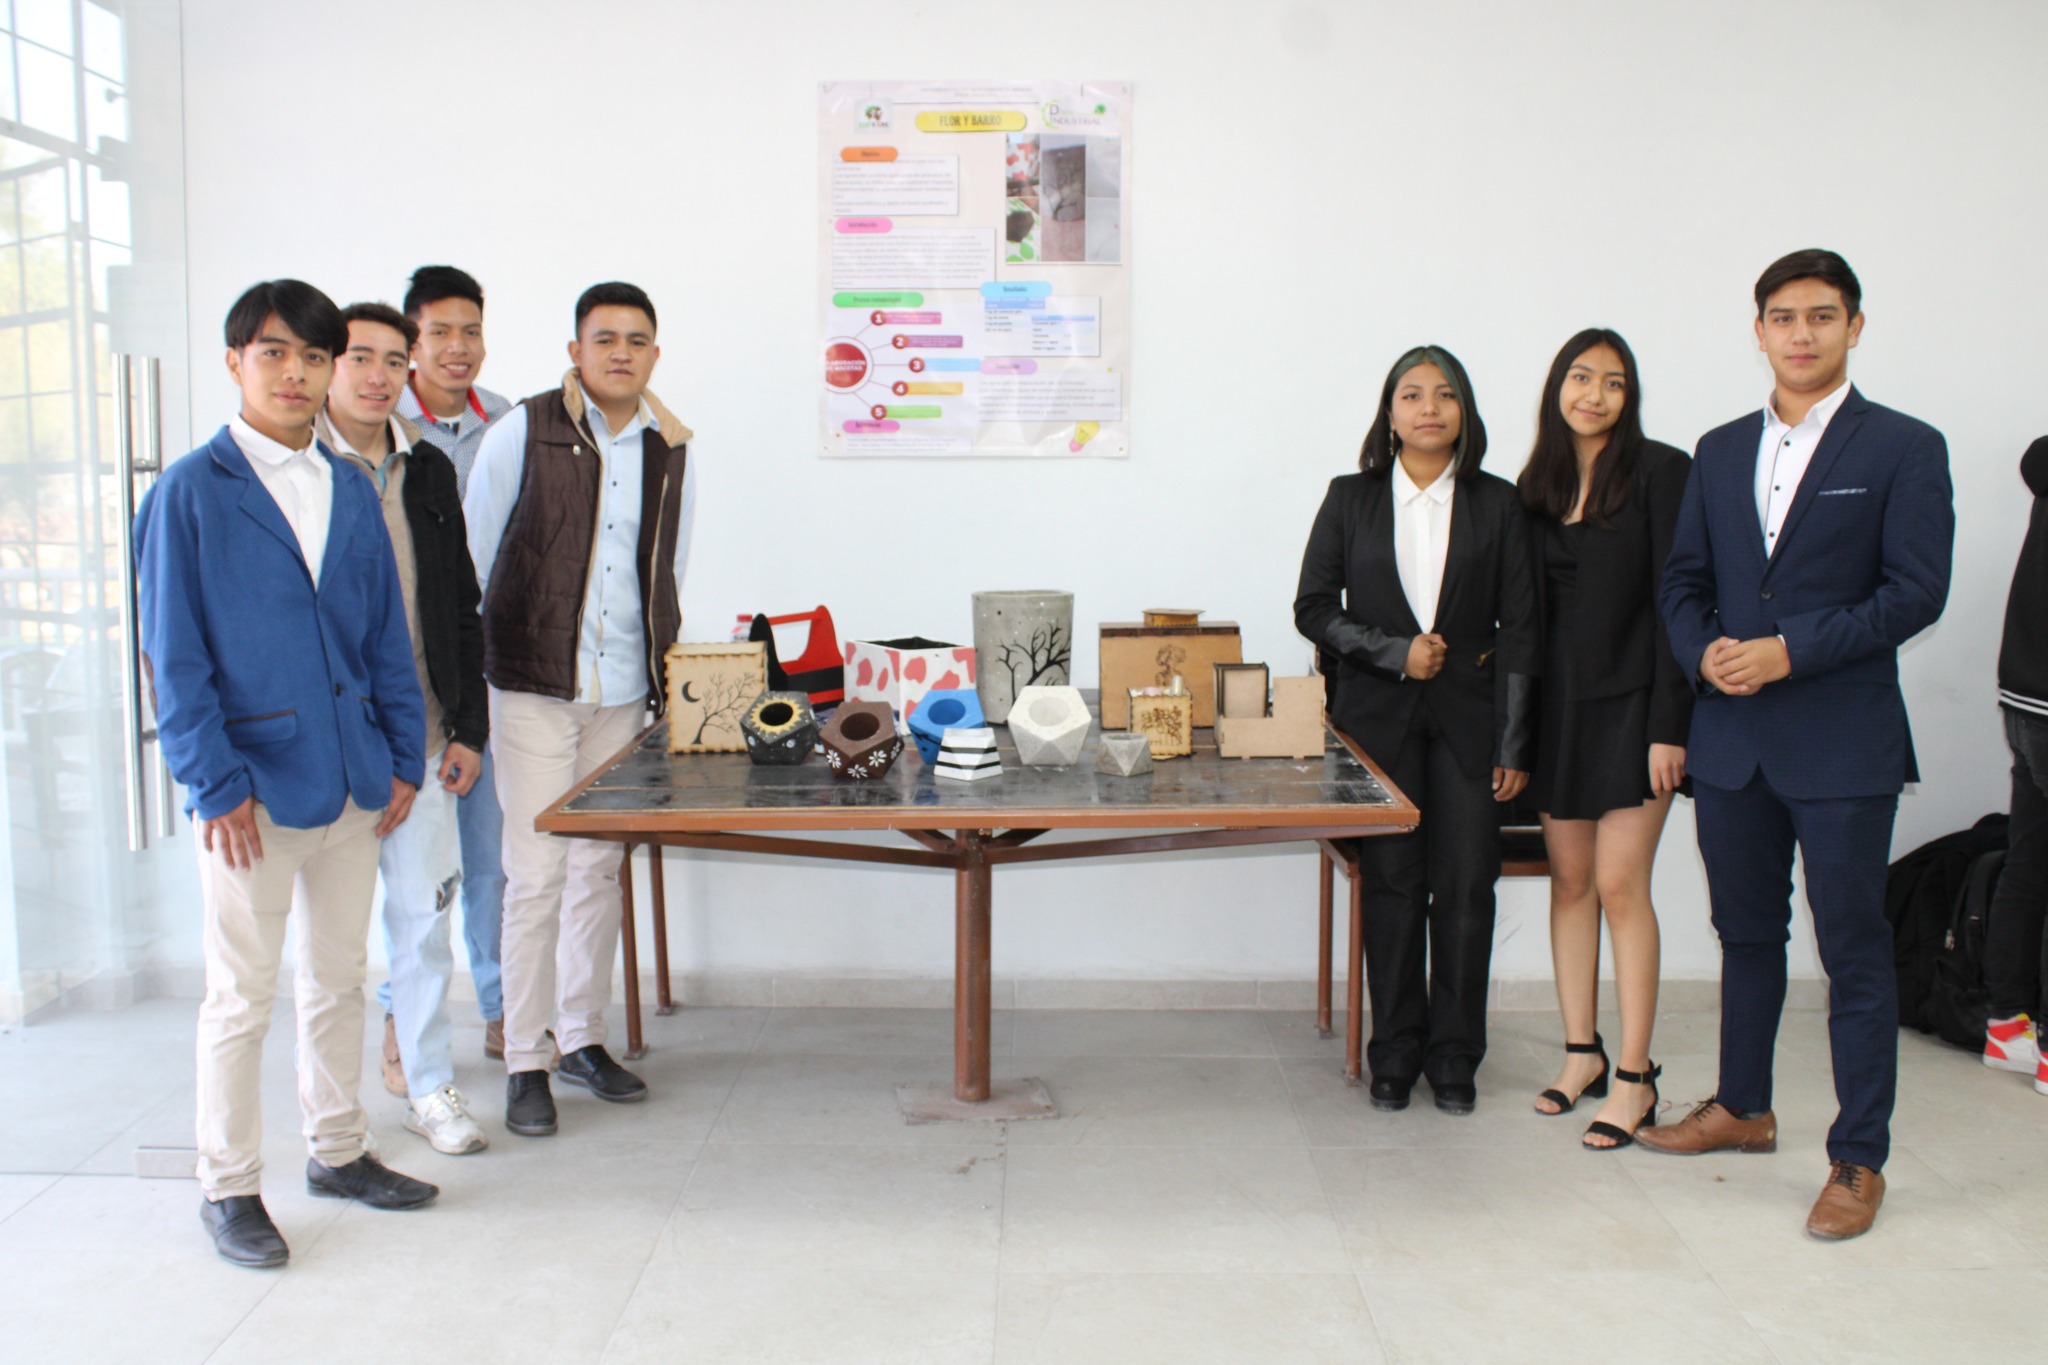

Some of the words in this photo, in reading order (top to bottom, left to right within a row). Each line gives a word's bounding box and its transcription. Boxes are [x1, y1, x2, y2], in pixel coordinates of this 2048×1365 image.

[939, 115, 961, 127] FLOR
[963, 115, 969, 126] Y
[971, 115, 1002, 126] BARRO
[875, 314, 882, 323] 1
[896, 337, 904, 346] 2
[912, 360, 921, 370] 3
[896, 384, 905, 394] 4
[874, 407, 883, 417] 5
